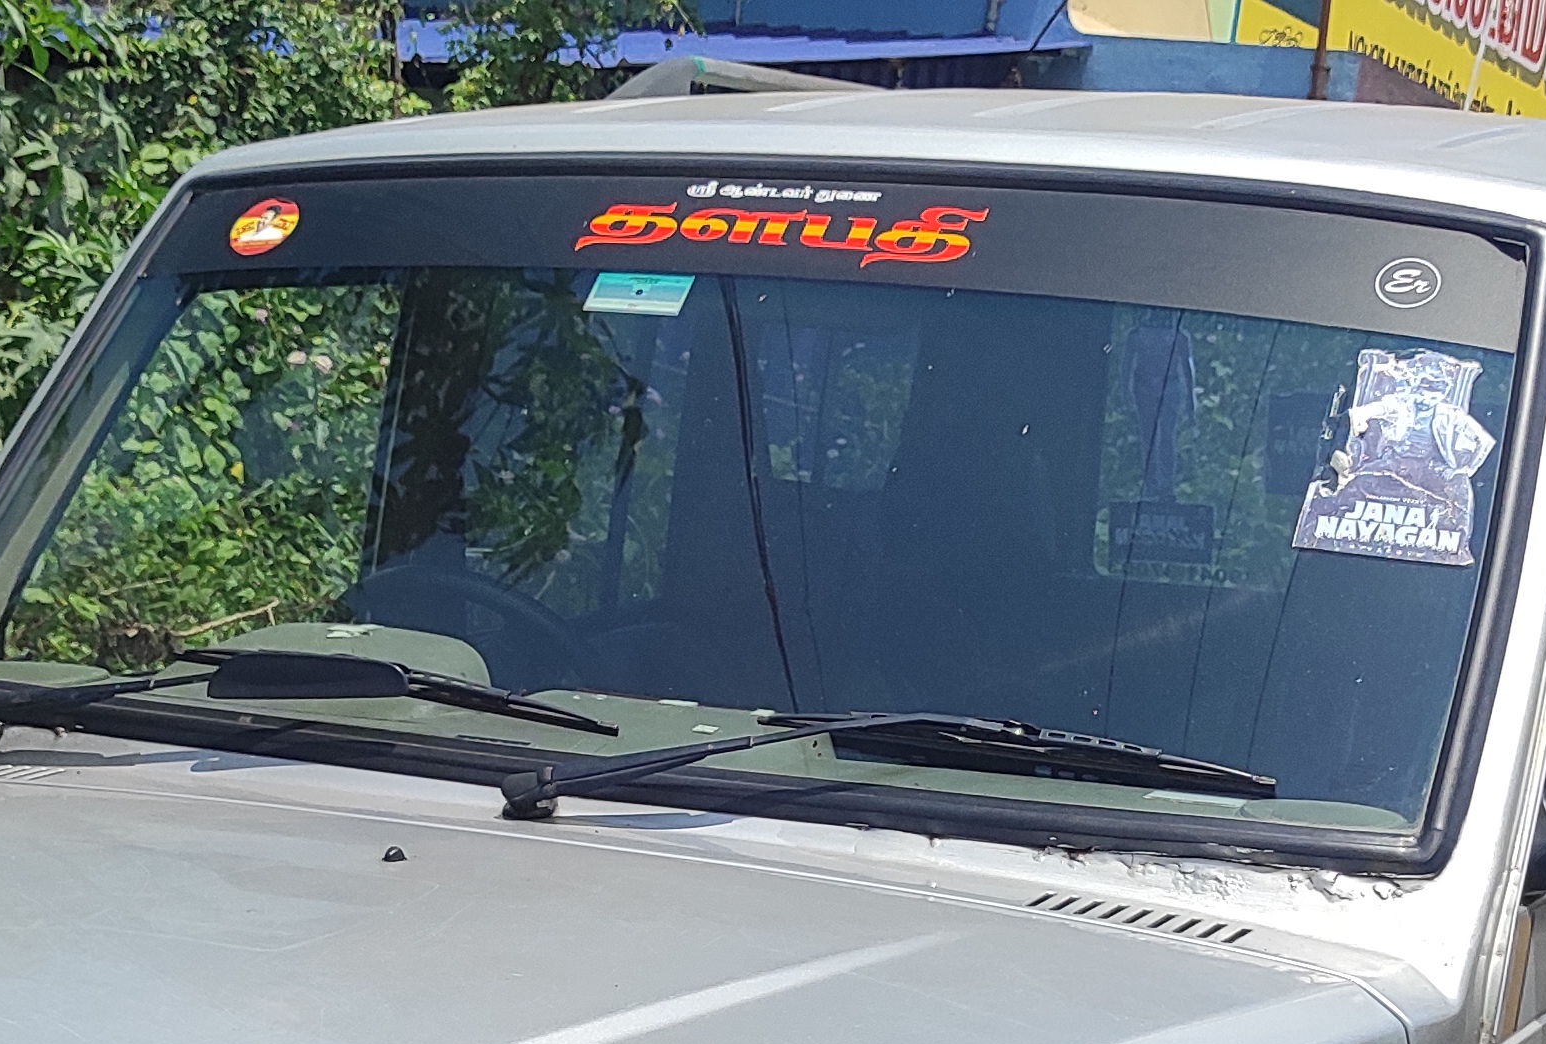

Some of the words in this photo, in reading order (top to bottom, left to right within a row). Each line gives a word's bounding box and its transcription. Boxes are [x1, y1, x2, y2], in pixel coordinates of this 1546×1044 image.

[573, 201, 991, 269] தளபதி
[1383, 268, 1432, 295] Er
[1344, 500, 1426, 528] JANA
[1313, 515, 1462, 554] NAYAGAN
